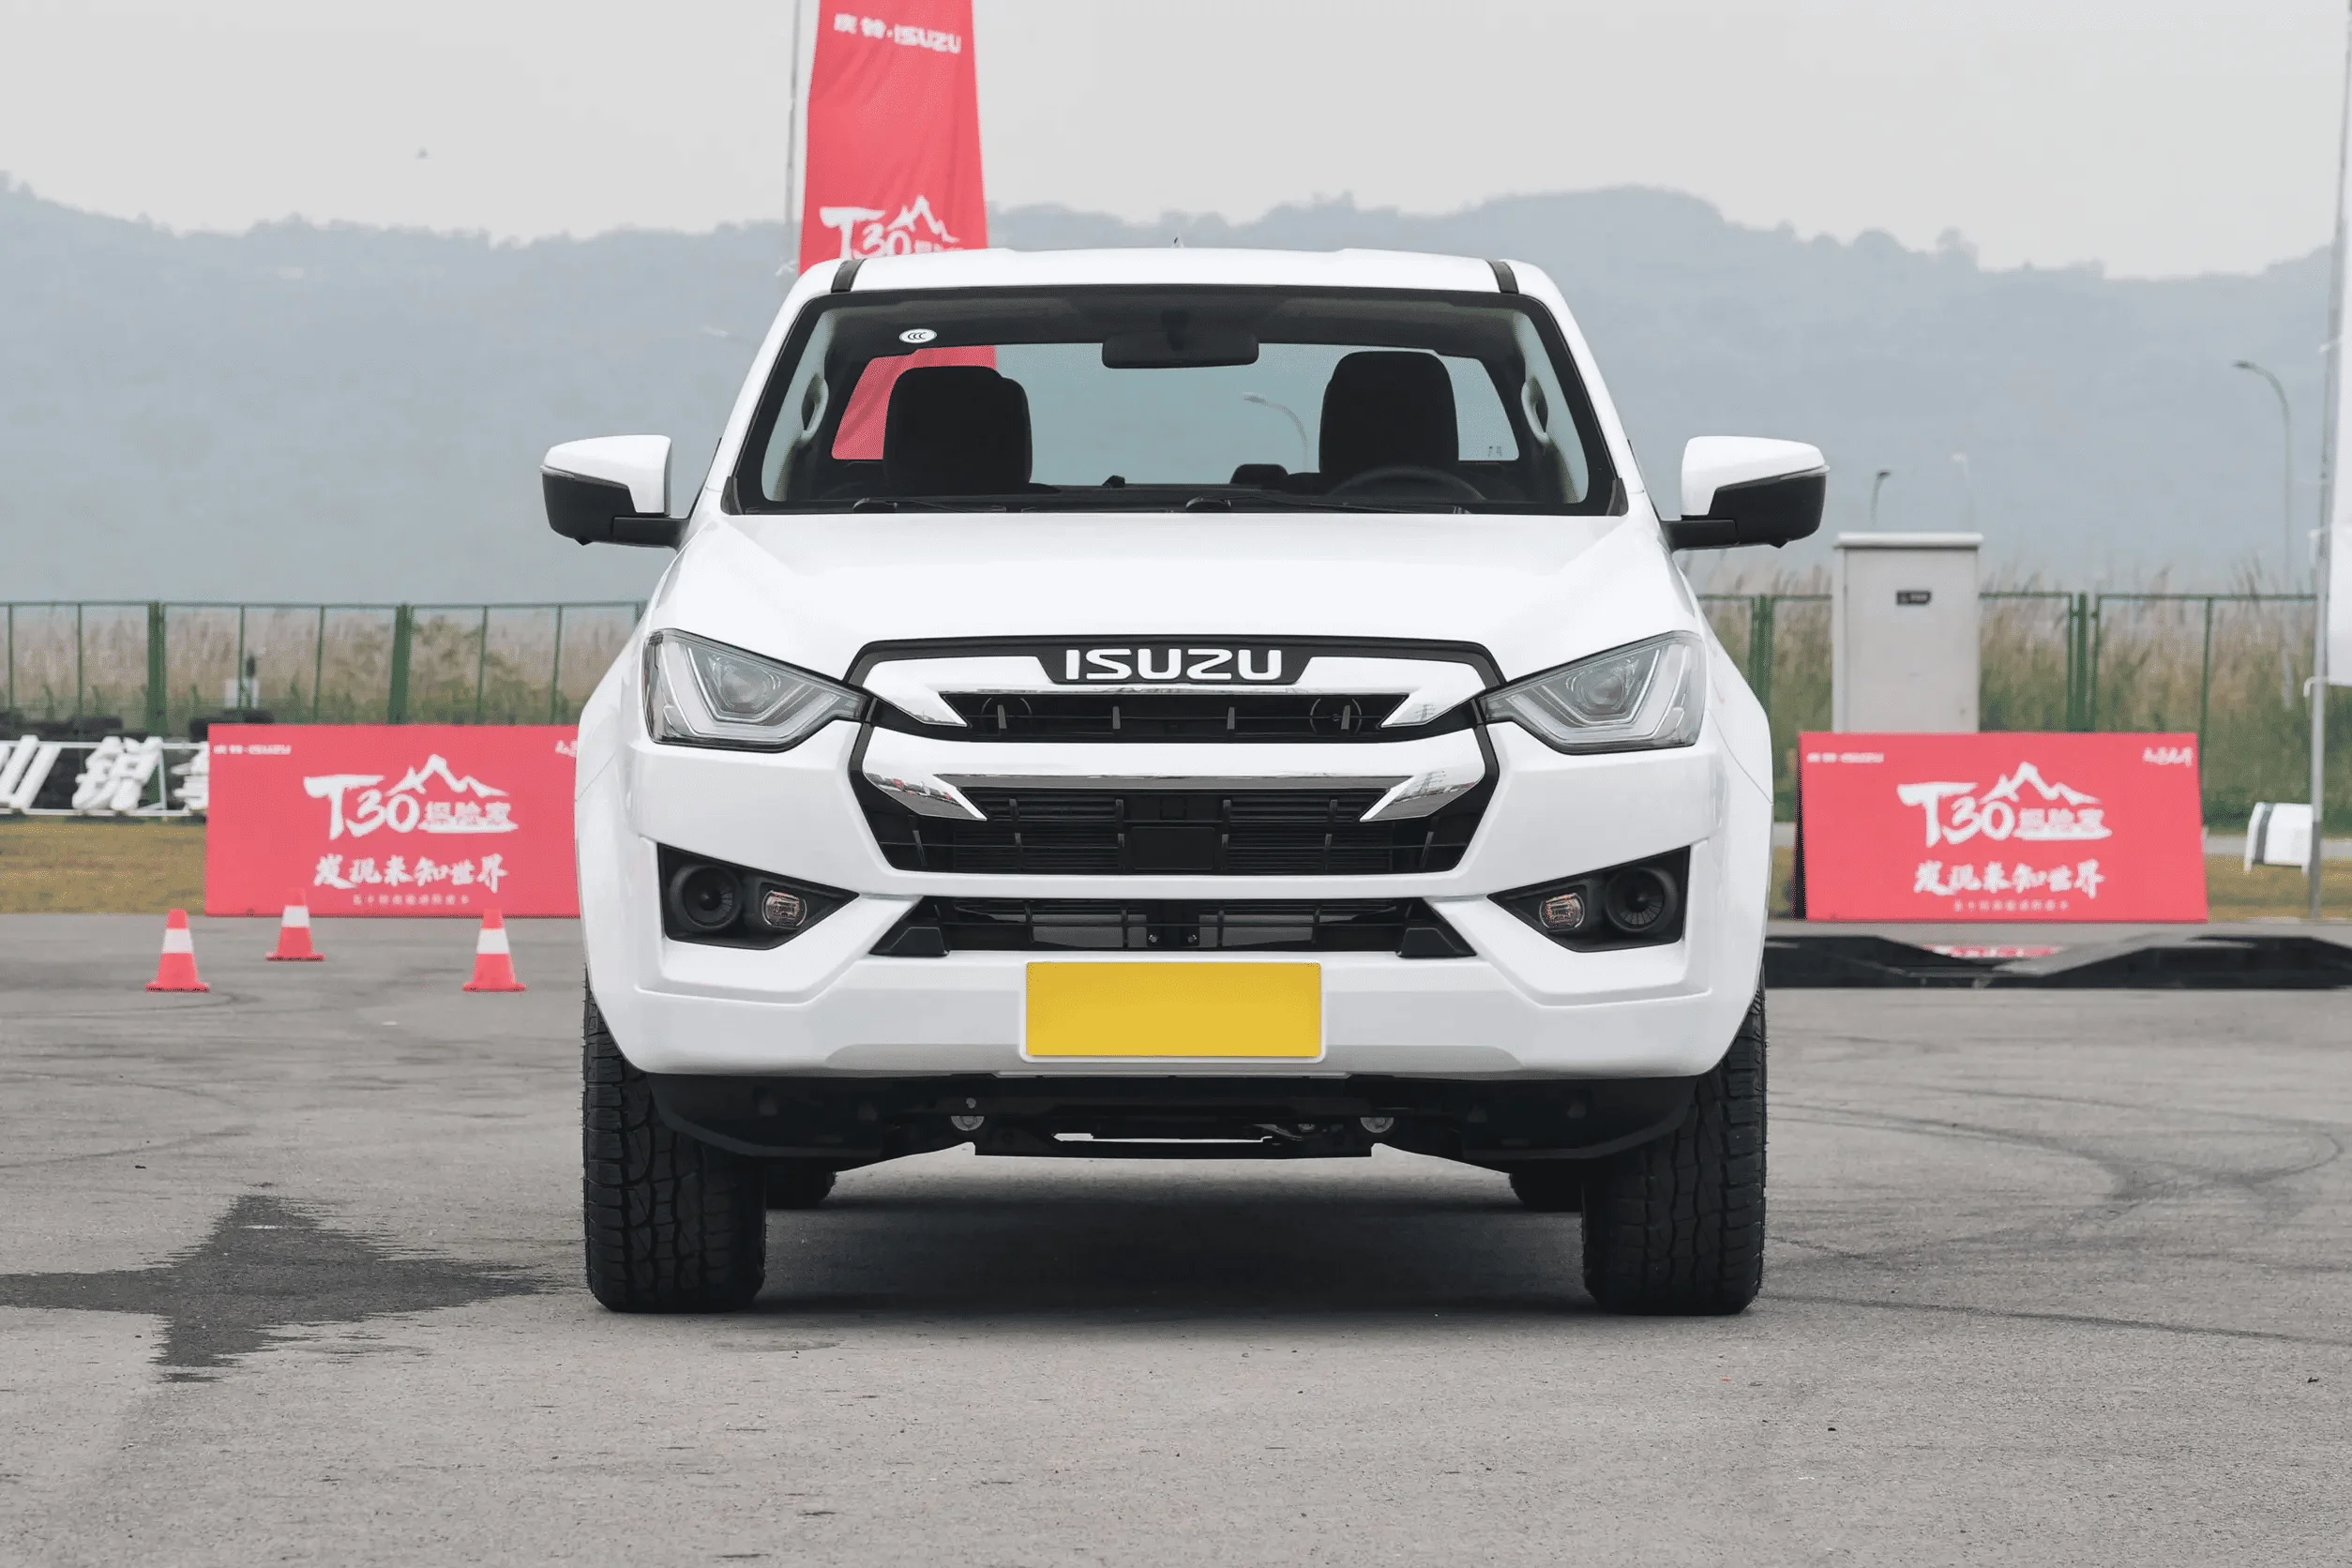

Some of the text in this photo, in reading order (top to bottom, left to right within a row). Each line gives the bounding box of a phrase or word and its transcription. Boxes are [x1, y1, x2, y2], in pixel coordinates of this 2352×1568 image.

[1065, 648, 1282, 681] ISUZU
[313, 852, 508, 894] 发现未知世界
[1914, 858, 2105, 899] 发现未知世界
